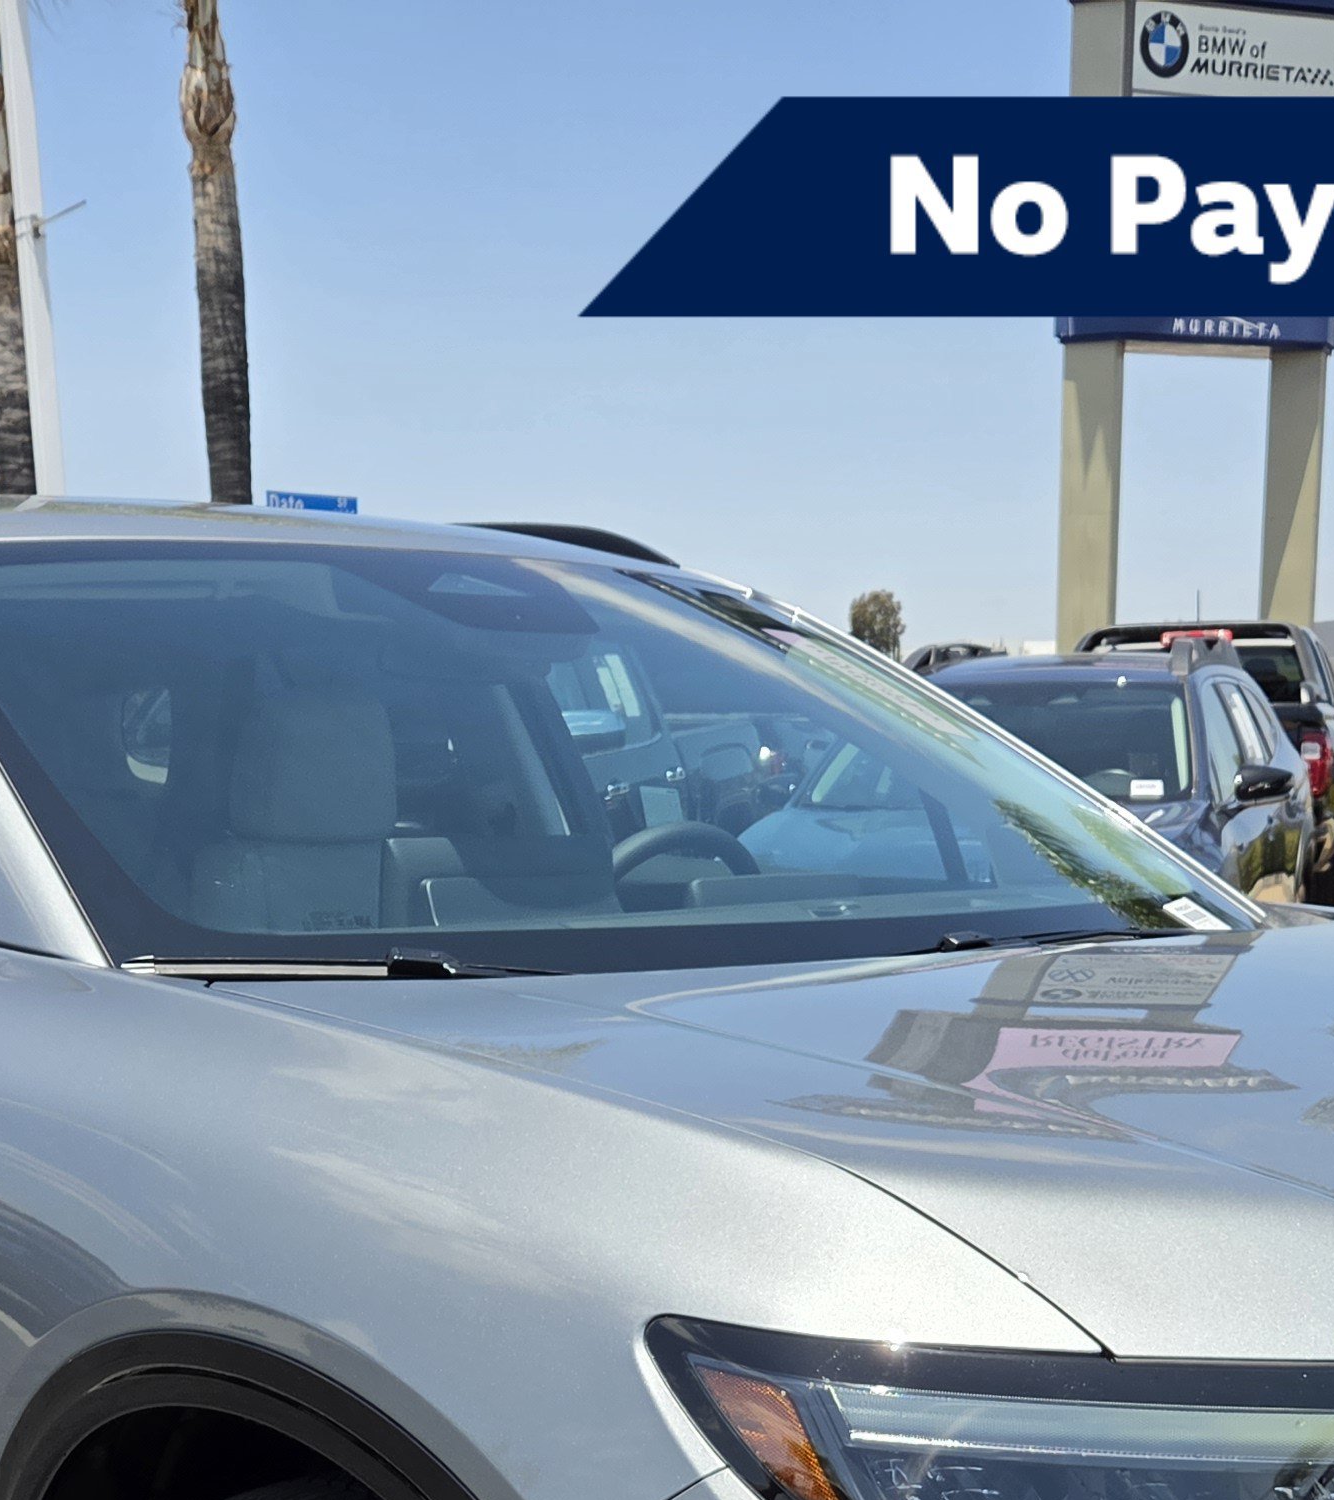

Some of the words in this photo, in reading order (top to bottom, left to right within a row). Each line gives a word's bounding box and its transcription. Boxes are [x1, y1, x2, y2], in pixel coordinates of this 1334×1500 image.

[1197, 35, 1247, 57] BMW
[1249, 41, 1267, 59] of
[1191, 60, 1309, 83] MURRIETA
[1172, 316, 1281, 340] MURRIETA
